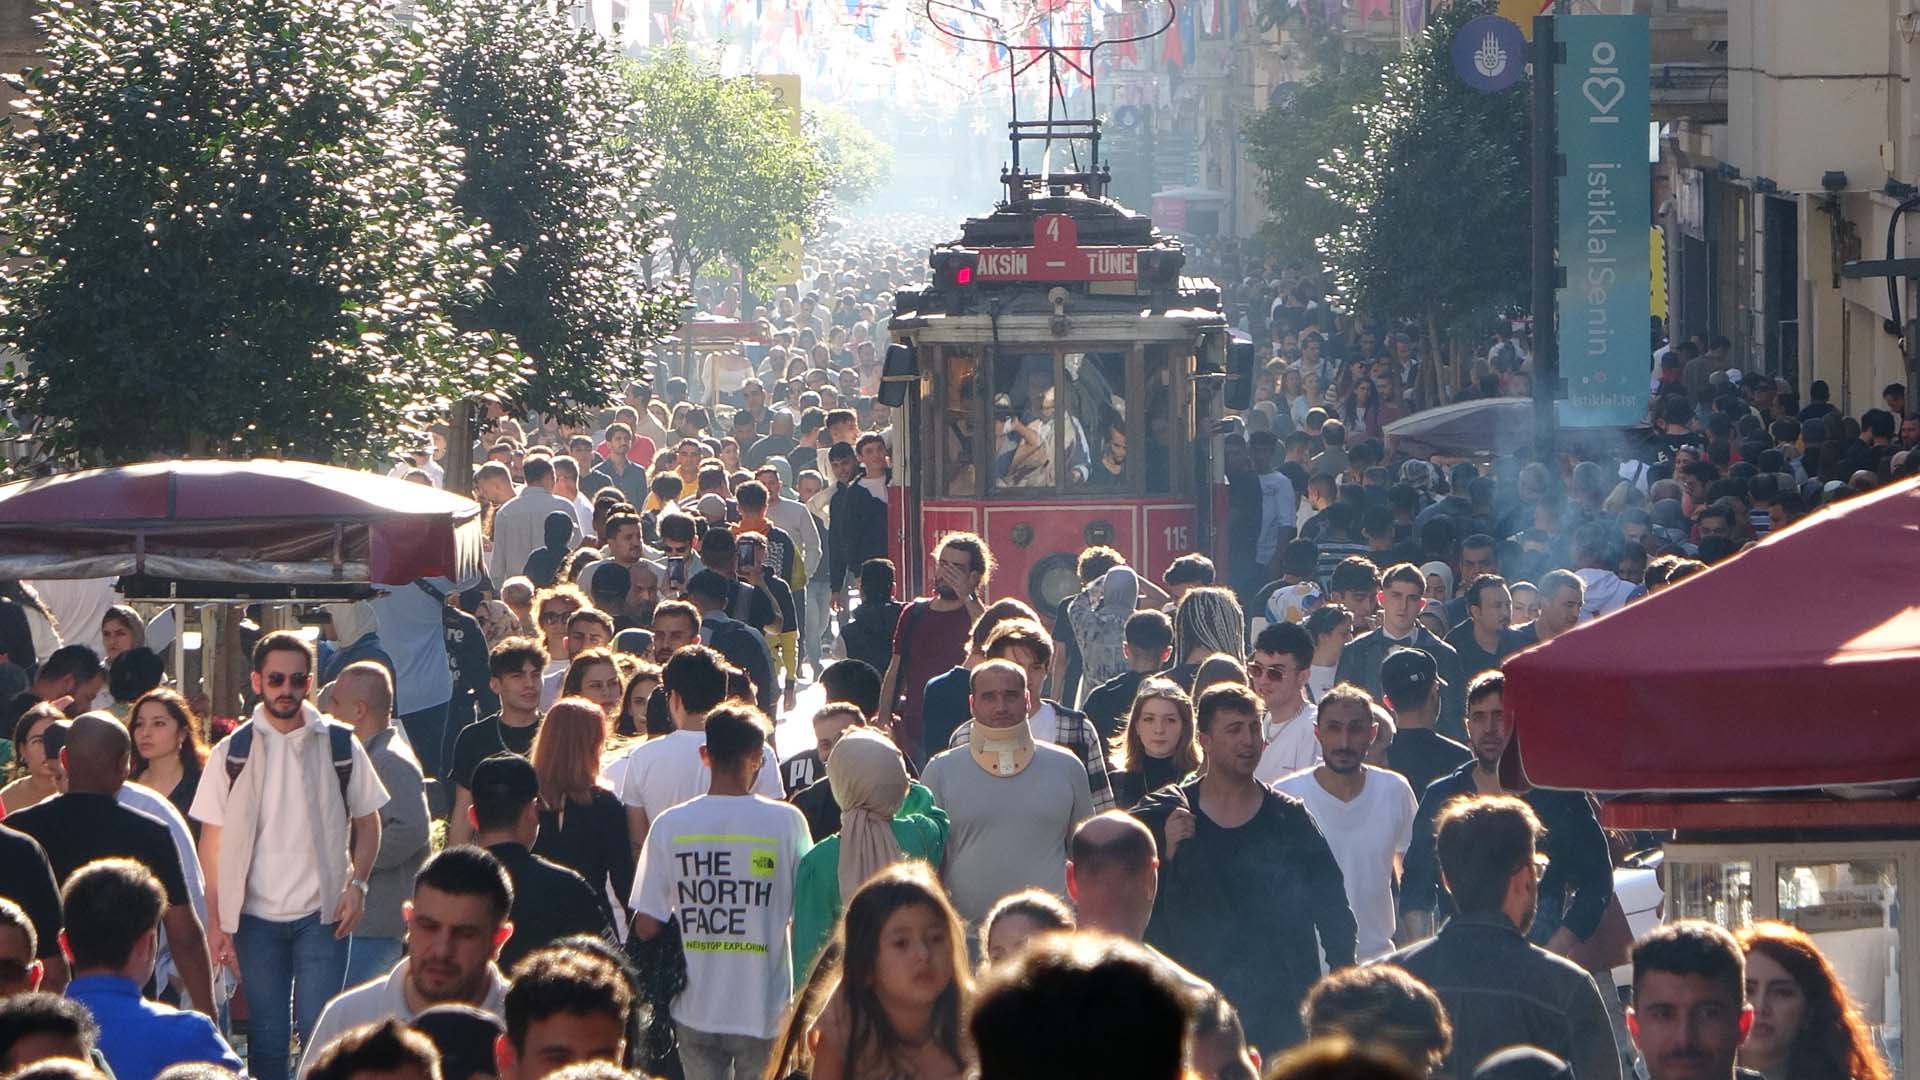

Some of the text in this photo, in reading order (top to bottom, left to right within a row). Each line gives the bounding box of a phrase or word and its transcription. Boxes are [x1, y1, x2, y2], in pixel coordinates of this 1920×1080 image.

[1046, 217, 1060, 241] 4
[977, 250, 1027, 275] AKSİM
[1163, 526, 1187, 550] 115
[676, 850, 732, 877] THE
[677, 879, 773, 907] NORTH
[681, 907, 746, 935] FACE
